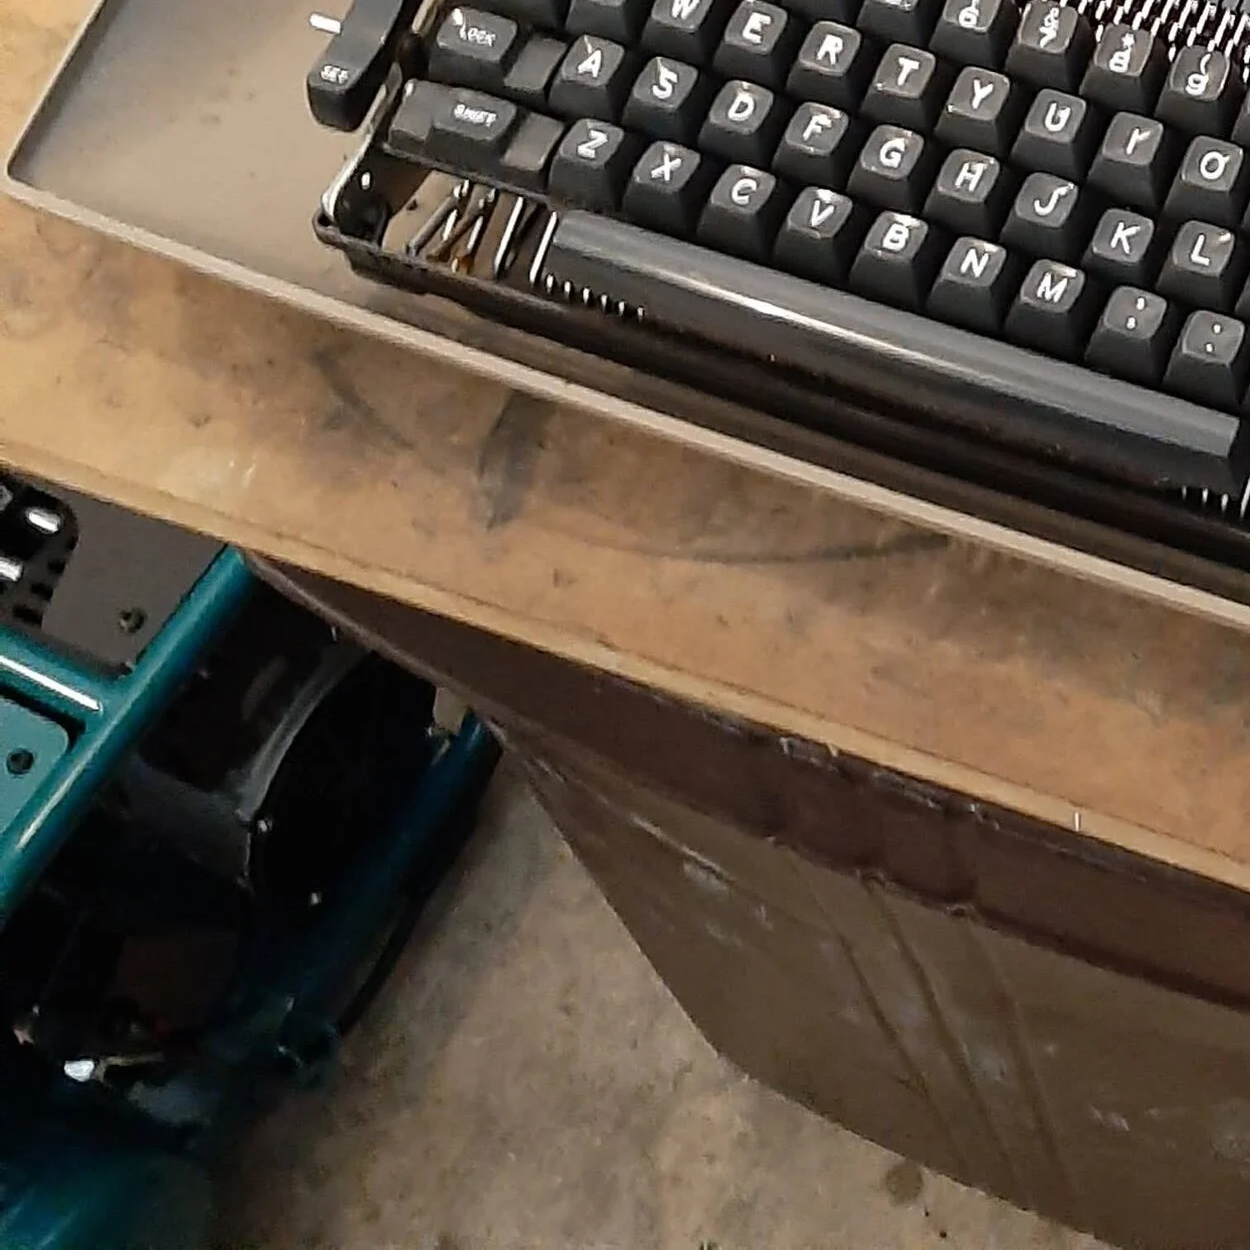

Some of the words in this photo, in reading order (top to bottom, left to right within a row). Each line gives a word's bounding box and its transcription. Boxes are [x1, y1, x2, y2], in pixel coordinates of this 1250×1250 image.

[742, 13, 771, 44] E
[577, 49, 602, 78] A
[816, 35, 843, 65] R
[652, 66, 678, 98] S
[898, 57, 919, 86] T
[727, 95, 754, 121] D
[972, 79, 993, 109] Y
[803, 114, 831, 141] F
[1044, 102, 1071, 132] U
[578, 129, 608, 158] Z
[880, 138, 906, 168] G
[650, 155, 682, 182] X
[954, 161, 984, 192] H
[1200, 150, 1228, 181] O
[731, 178, 757, 205] C
[1034, 187, 1066, 217] J
[810, 199, 835, 227] V
[882, 222, 910, 251] B
[1110, 221, 1140, 254] K
[1191, 234, 1210, 266] L
[960, 248, 989, 278] N
[1037, 271, 1068, 303] M
